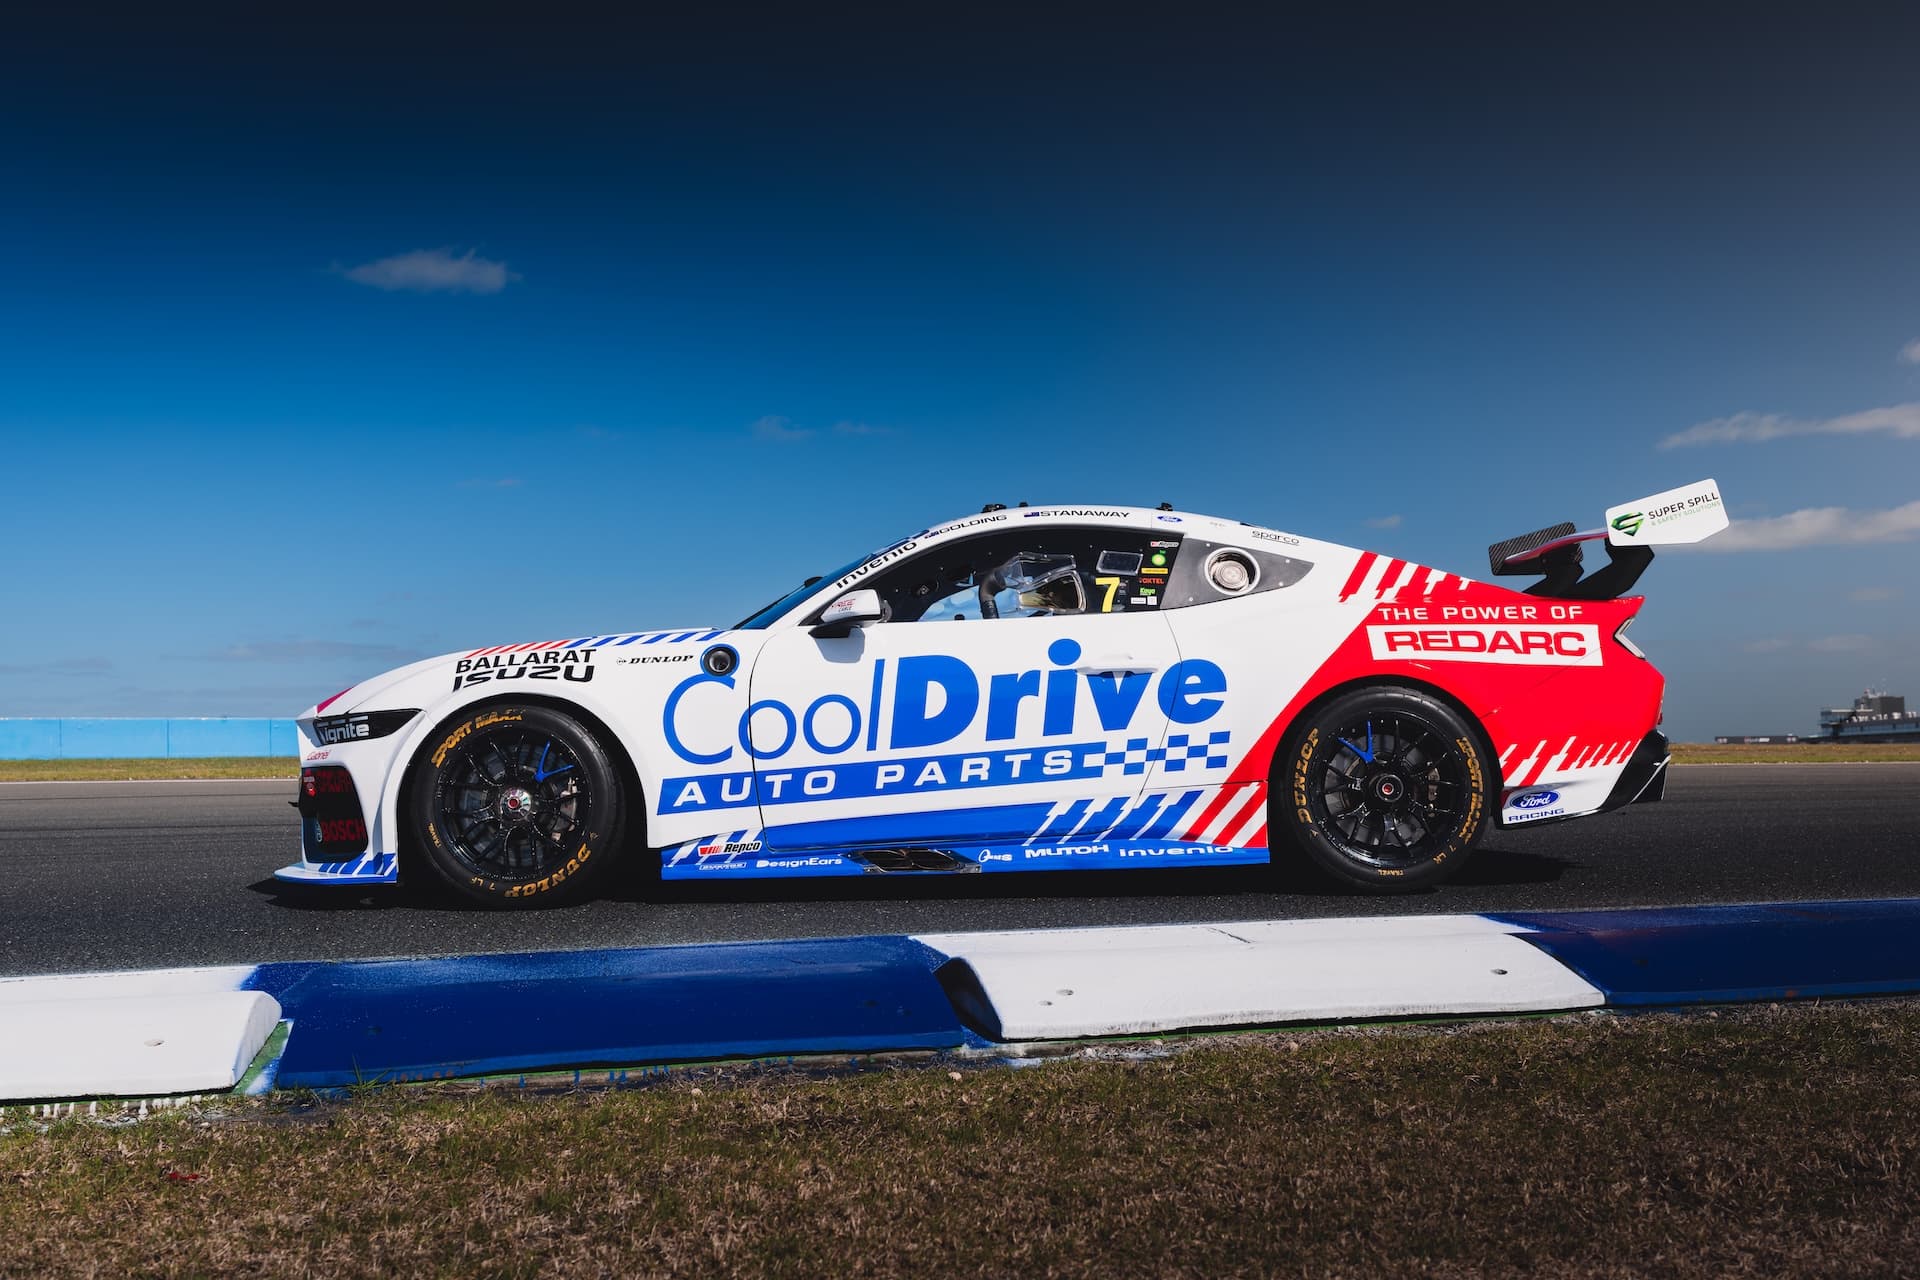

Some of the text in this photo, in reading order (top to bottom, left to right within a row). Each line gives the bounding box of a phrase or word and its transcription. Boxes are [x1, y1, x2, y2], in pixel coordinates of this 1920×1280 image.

[1040, 509, 1131, 518] STANAWAY
[1648, 492, 1719, 520] SUPER SPILL
[938, 514, 1008, 535] GOLDING
[1252, 530, 1301, 546] sparco
[1095, 577, 1120, 613] 7
[1377, 606, 1584, 621] THE POWER OF
[1384, 630, 1587, 656] REDARC
[455, 649, 597, 674] BALLARAT
[628, 655, 694, 664] DUNLOP
[452, 665, 595, 693] ISUZU
[673, 748, 1074, 808] AUTO PARTS
[1293, 727, 1320, 825] DUNLOP
[1520, 793, 1551, 808] Ford
[1508, 808, 1565, 821] RACING
[724, 841, 761, 854] Repco
[504, 843, 592, 899] DUNLOP
